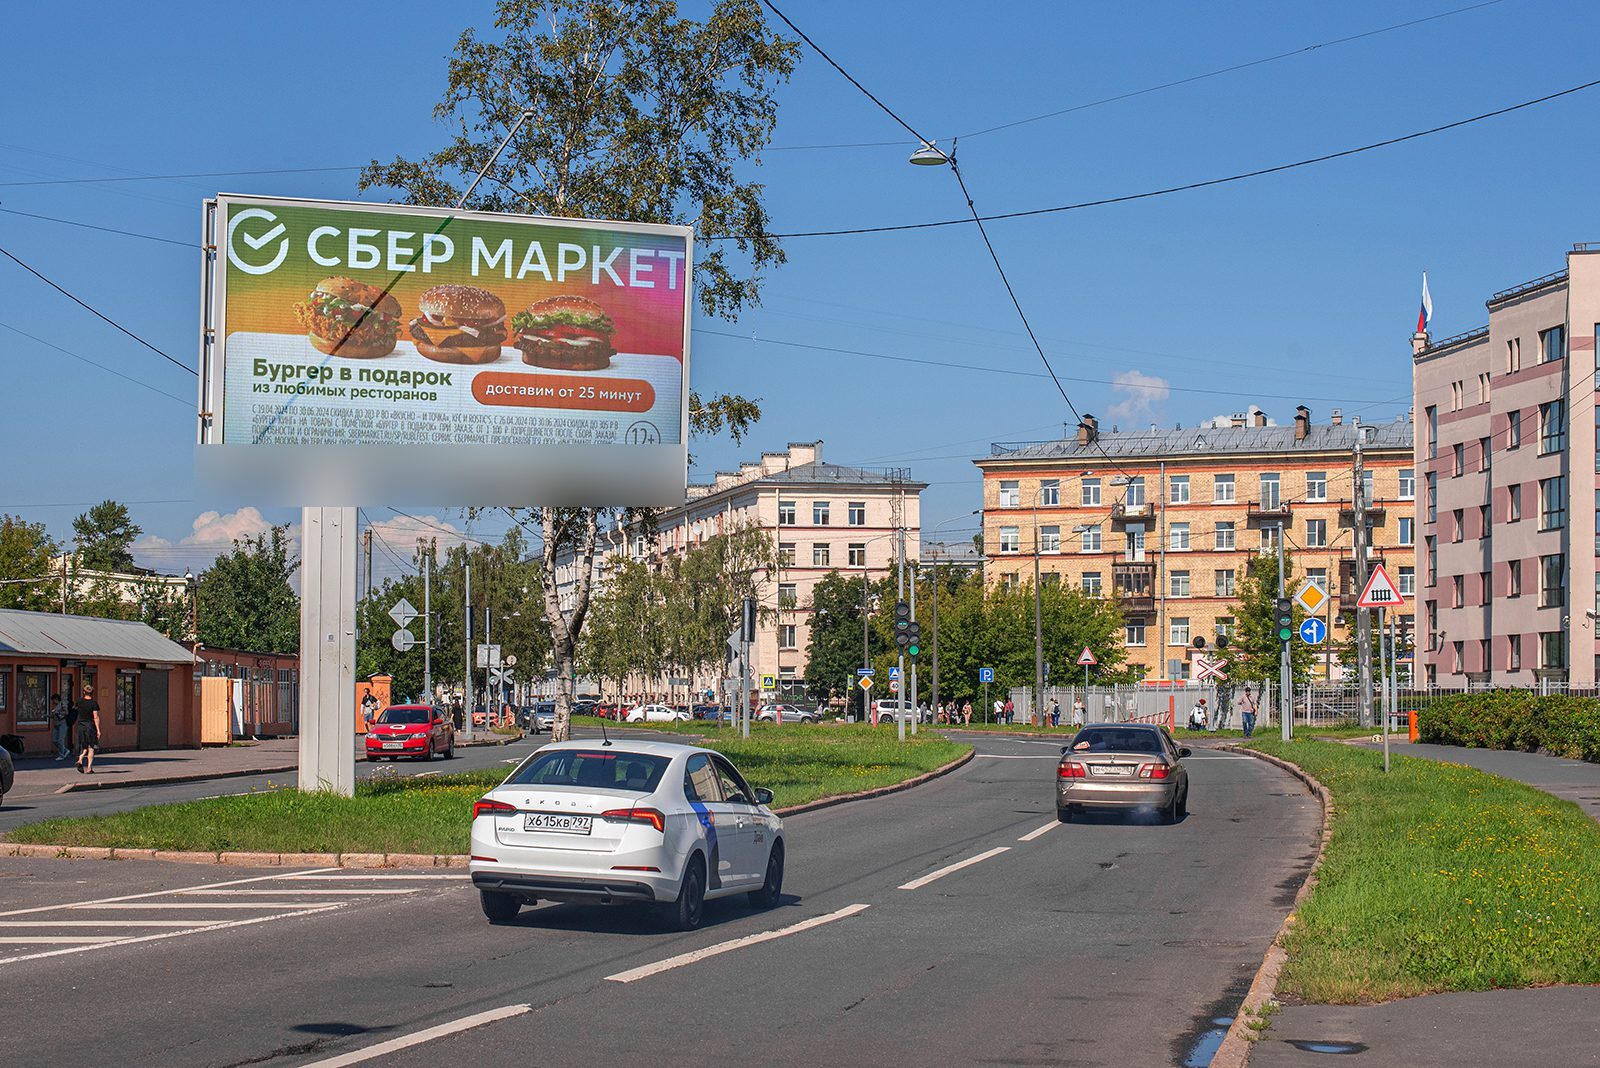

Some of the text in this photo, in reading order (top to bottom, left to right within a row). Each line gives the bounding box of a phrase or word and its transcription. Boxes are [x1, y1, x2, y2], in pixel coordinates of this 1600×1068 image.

[307, 226, 685, 290] СБЕР МАРКЕТ
[253, 358, 453, 389] Бургер в подарок
[253, 382, 437, 402] из любимых ресторанов
[485, 384, 642, 404] доставим от 25 минут
[289, 405, 298, 415] ПО
[330, 407, 353, 417] СКИДКА
[355, 408, 363, 418] ДО
[381, 410, 389, 419] ВО
[568, 418, 588, 428] СКИДКА
[298, 416, 307, 426] НА
[310, 416, 332, 427] ТОВАРЫ
[439, 422, 450, 432] ПРИ
[454, 423, 474, 433] ЗАКАЗЕ
